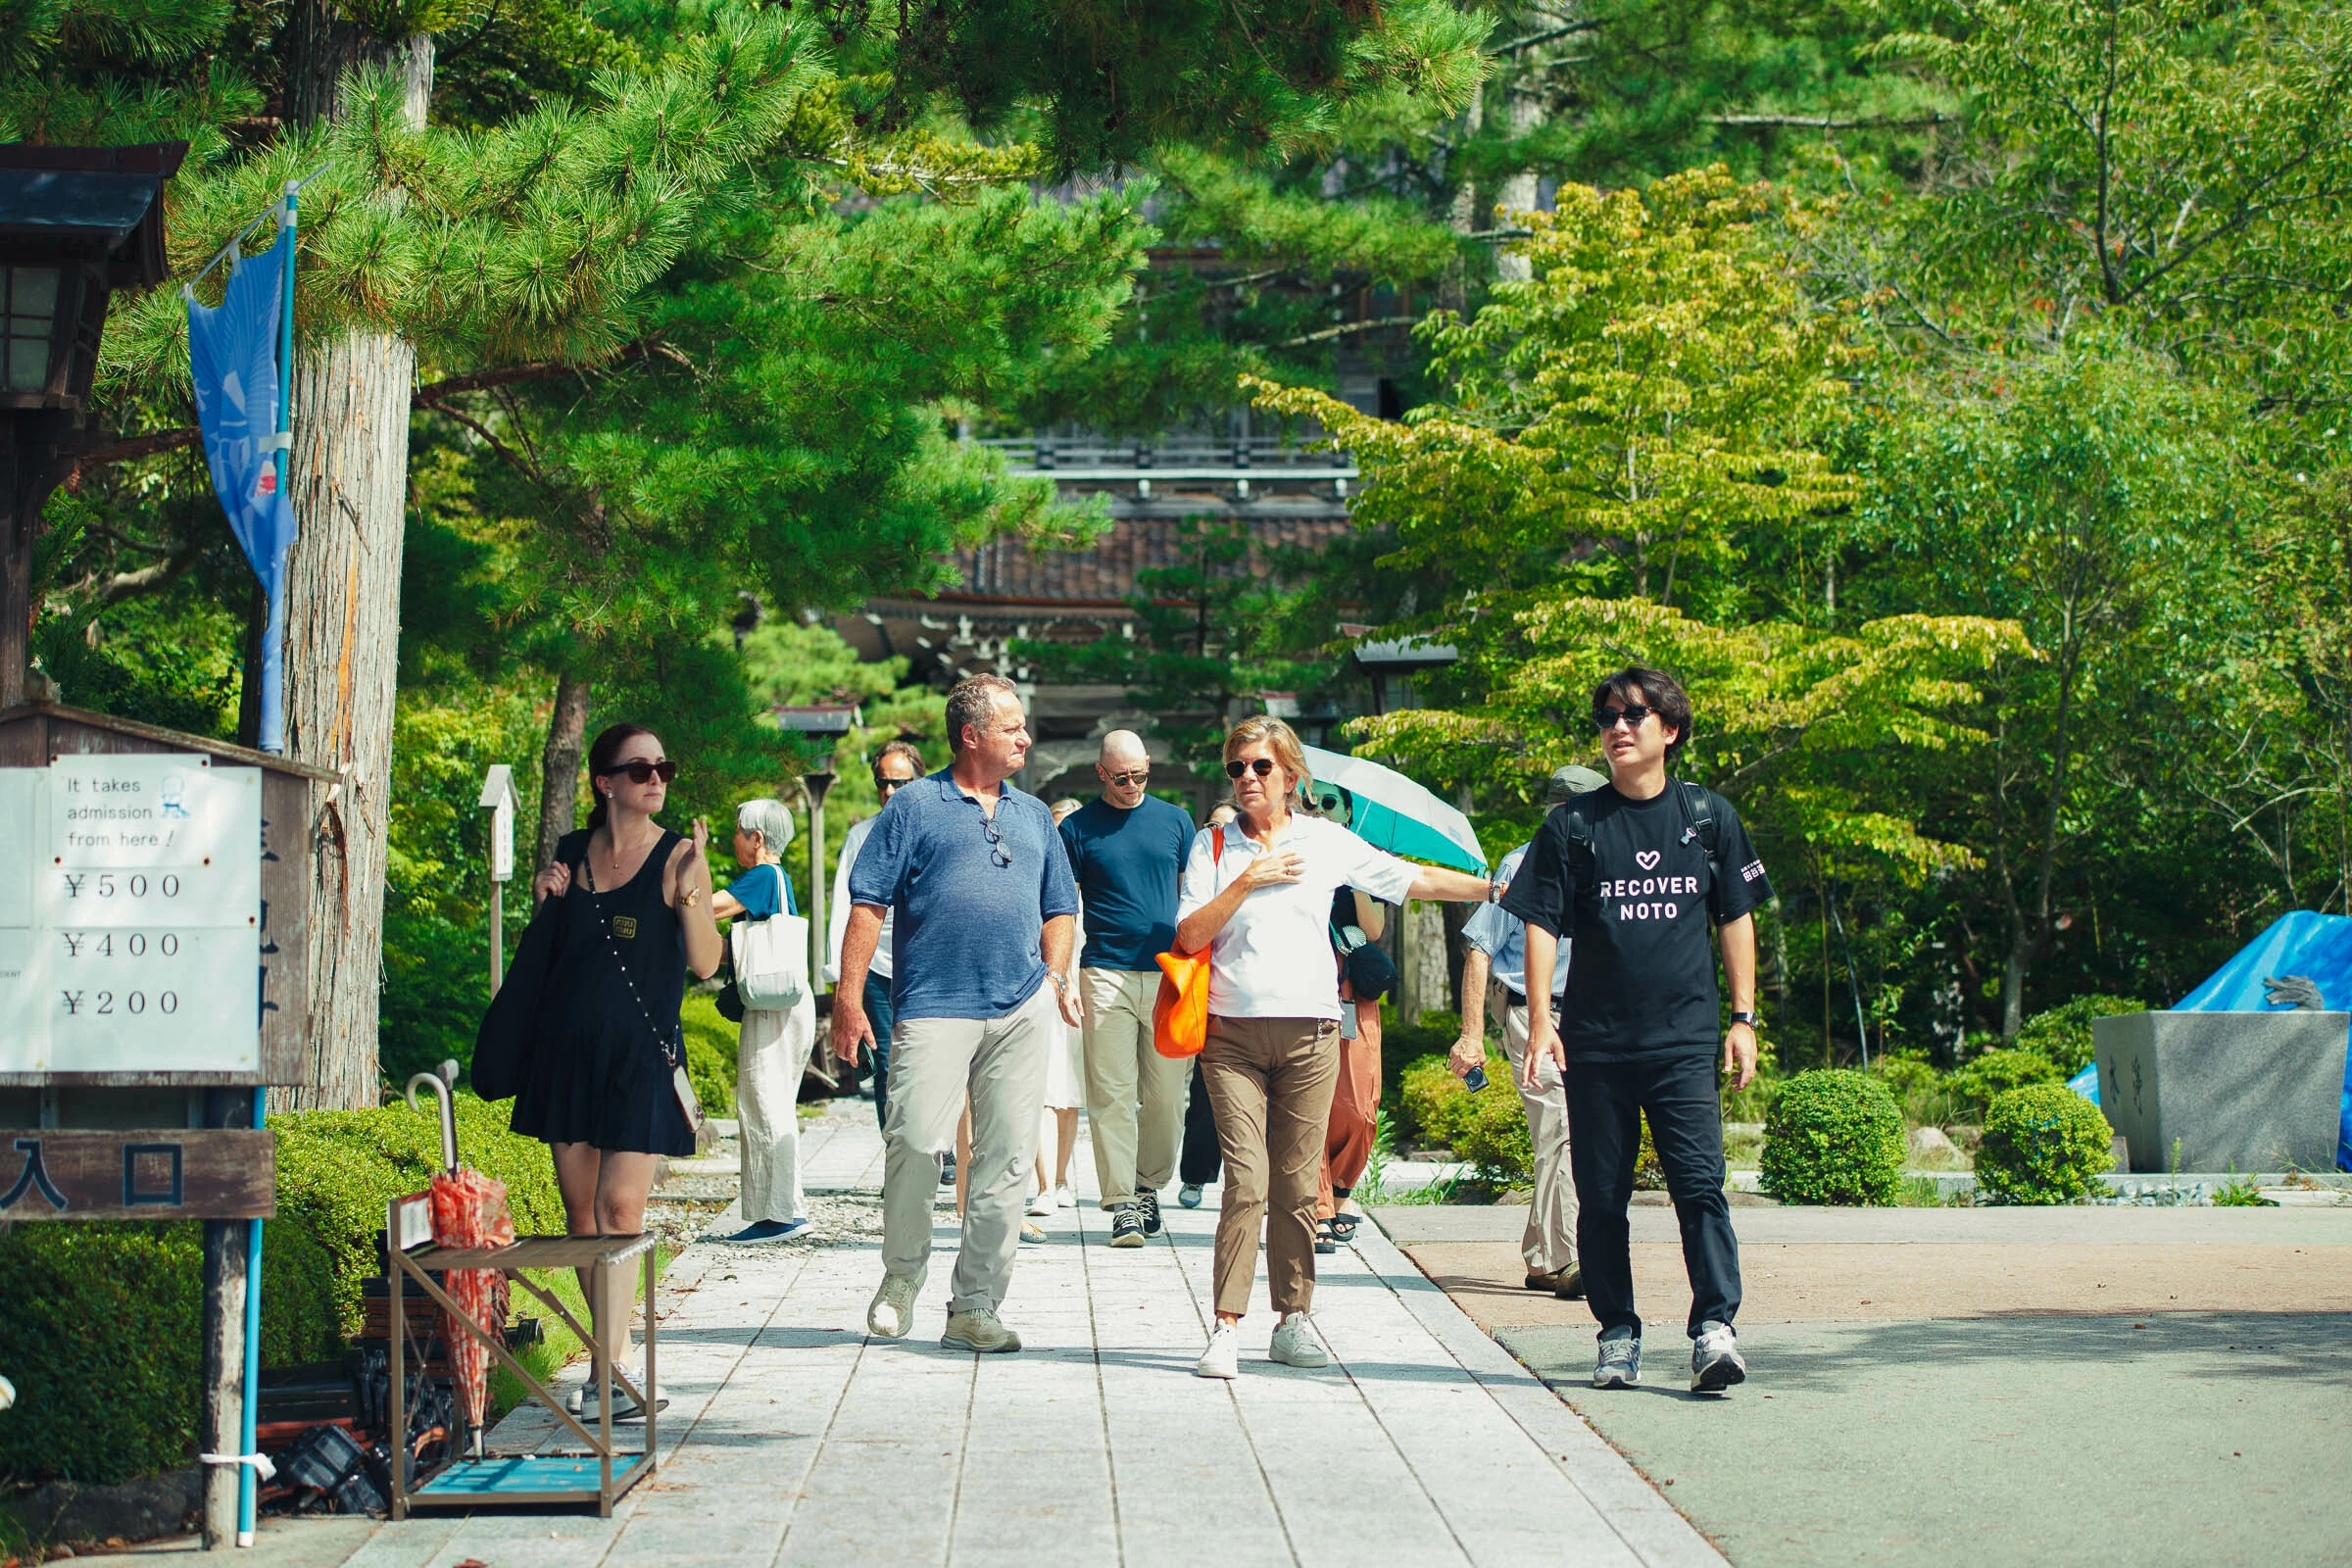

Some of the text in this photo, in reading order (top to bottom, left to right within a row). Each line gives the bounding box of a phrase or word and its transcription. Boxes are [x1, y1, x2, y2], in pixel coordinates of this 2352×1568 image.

[68, 779, 141, 793] It takes
[68, 806, 153, 820] admission
[69, 832, 111, 847] from
[65, 874, 179, 898] ¥500
[1600, 876, 1697, 898] RECOVER
[1620, 903, 1678, 920] NOTO
[62, 933, 178, 956] ¥400
[62, 991, 178, 1014] ¥200
[0, 1139, 184, 1210] 入口
